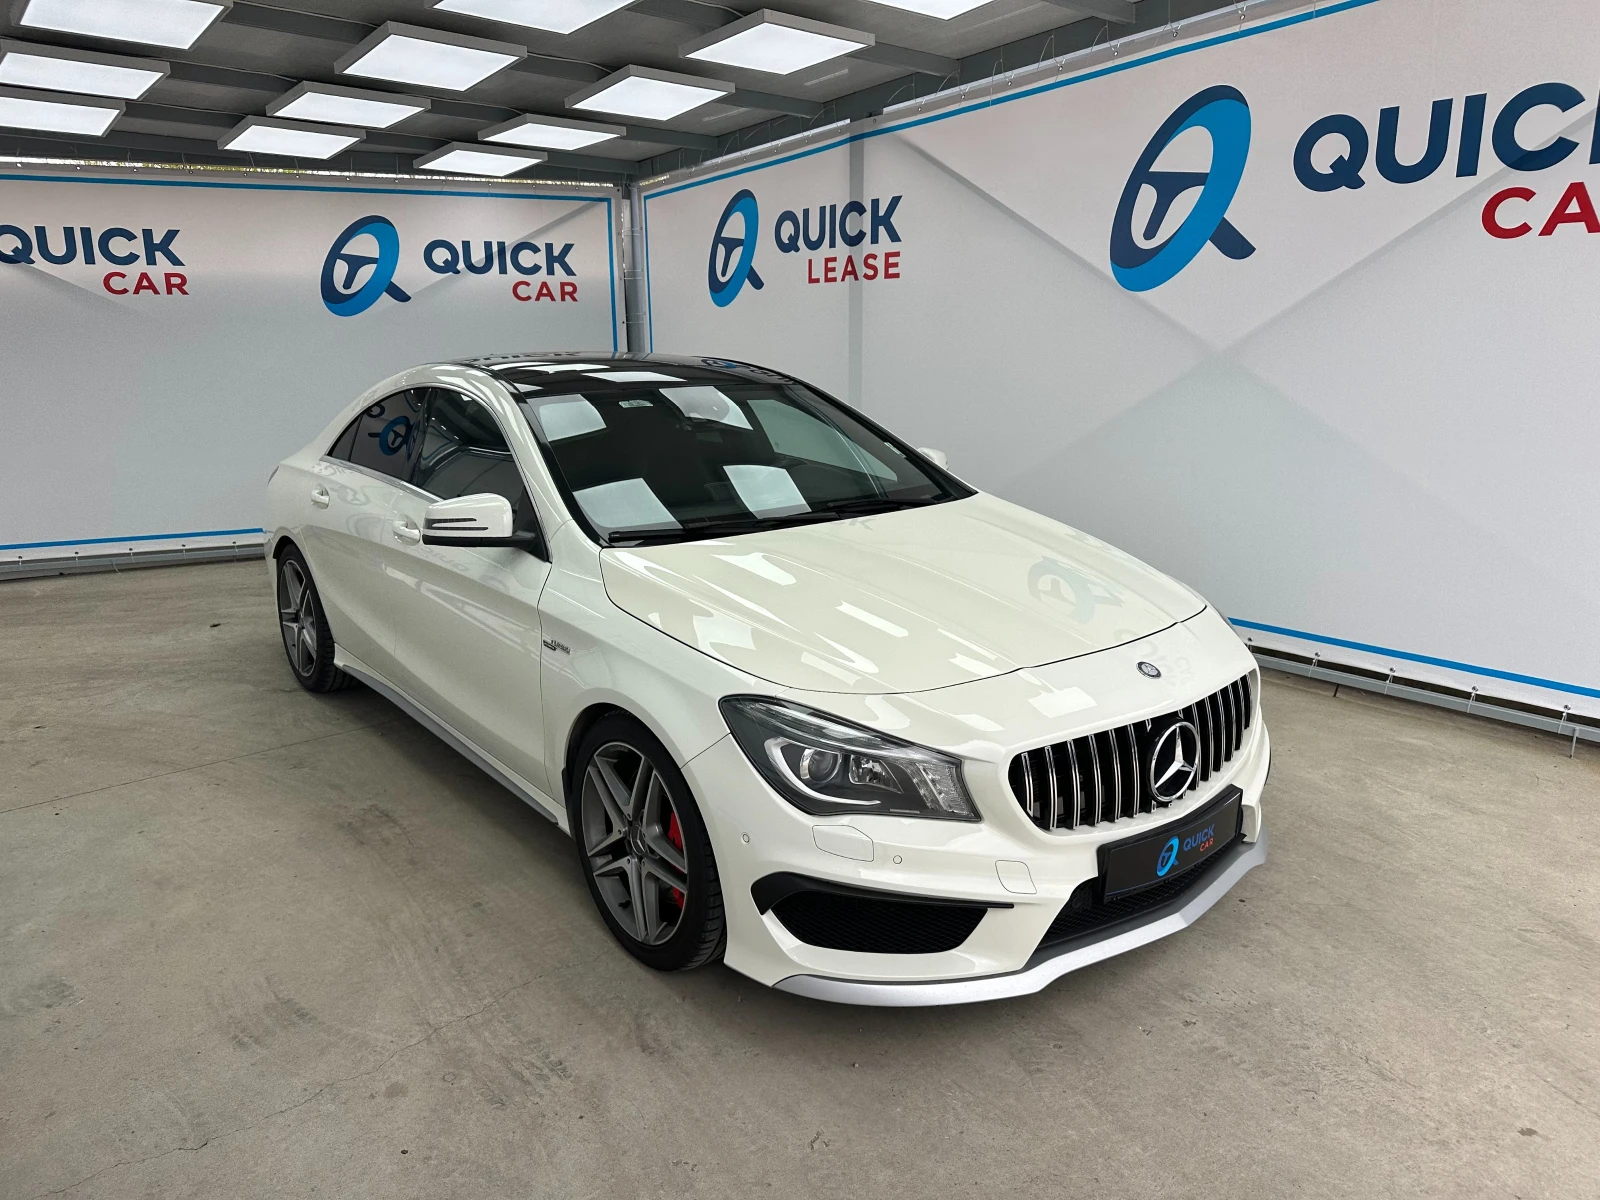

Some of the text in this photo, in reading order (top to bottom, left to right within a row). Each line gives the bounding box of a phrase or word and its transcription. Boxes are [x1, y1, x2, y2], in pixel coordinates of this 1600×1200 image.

[1293, 82, 1600, 193] QUIC
[774, 195, 901, 253] QUICK
[0, 224, 186, 266] QUICK
[423, 239, 577, 277] QUICK
[103, 271, 189, 295] CAR
[808, 251, 900, 284] LEASE
[512, 280, 578, 302] CAR
[1183, 824, 1216, 851] QUICK
[1199, 837, 1214, 851] CAR
